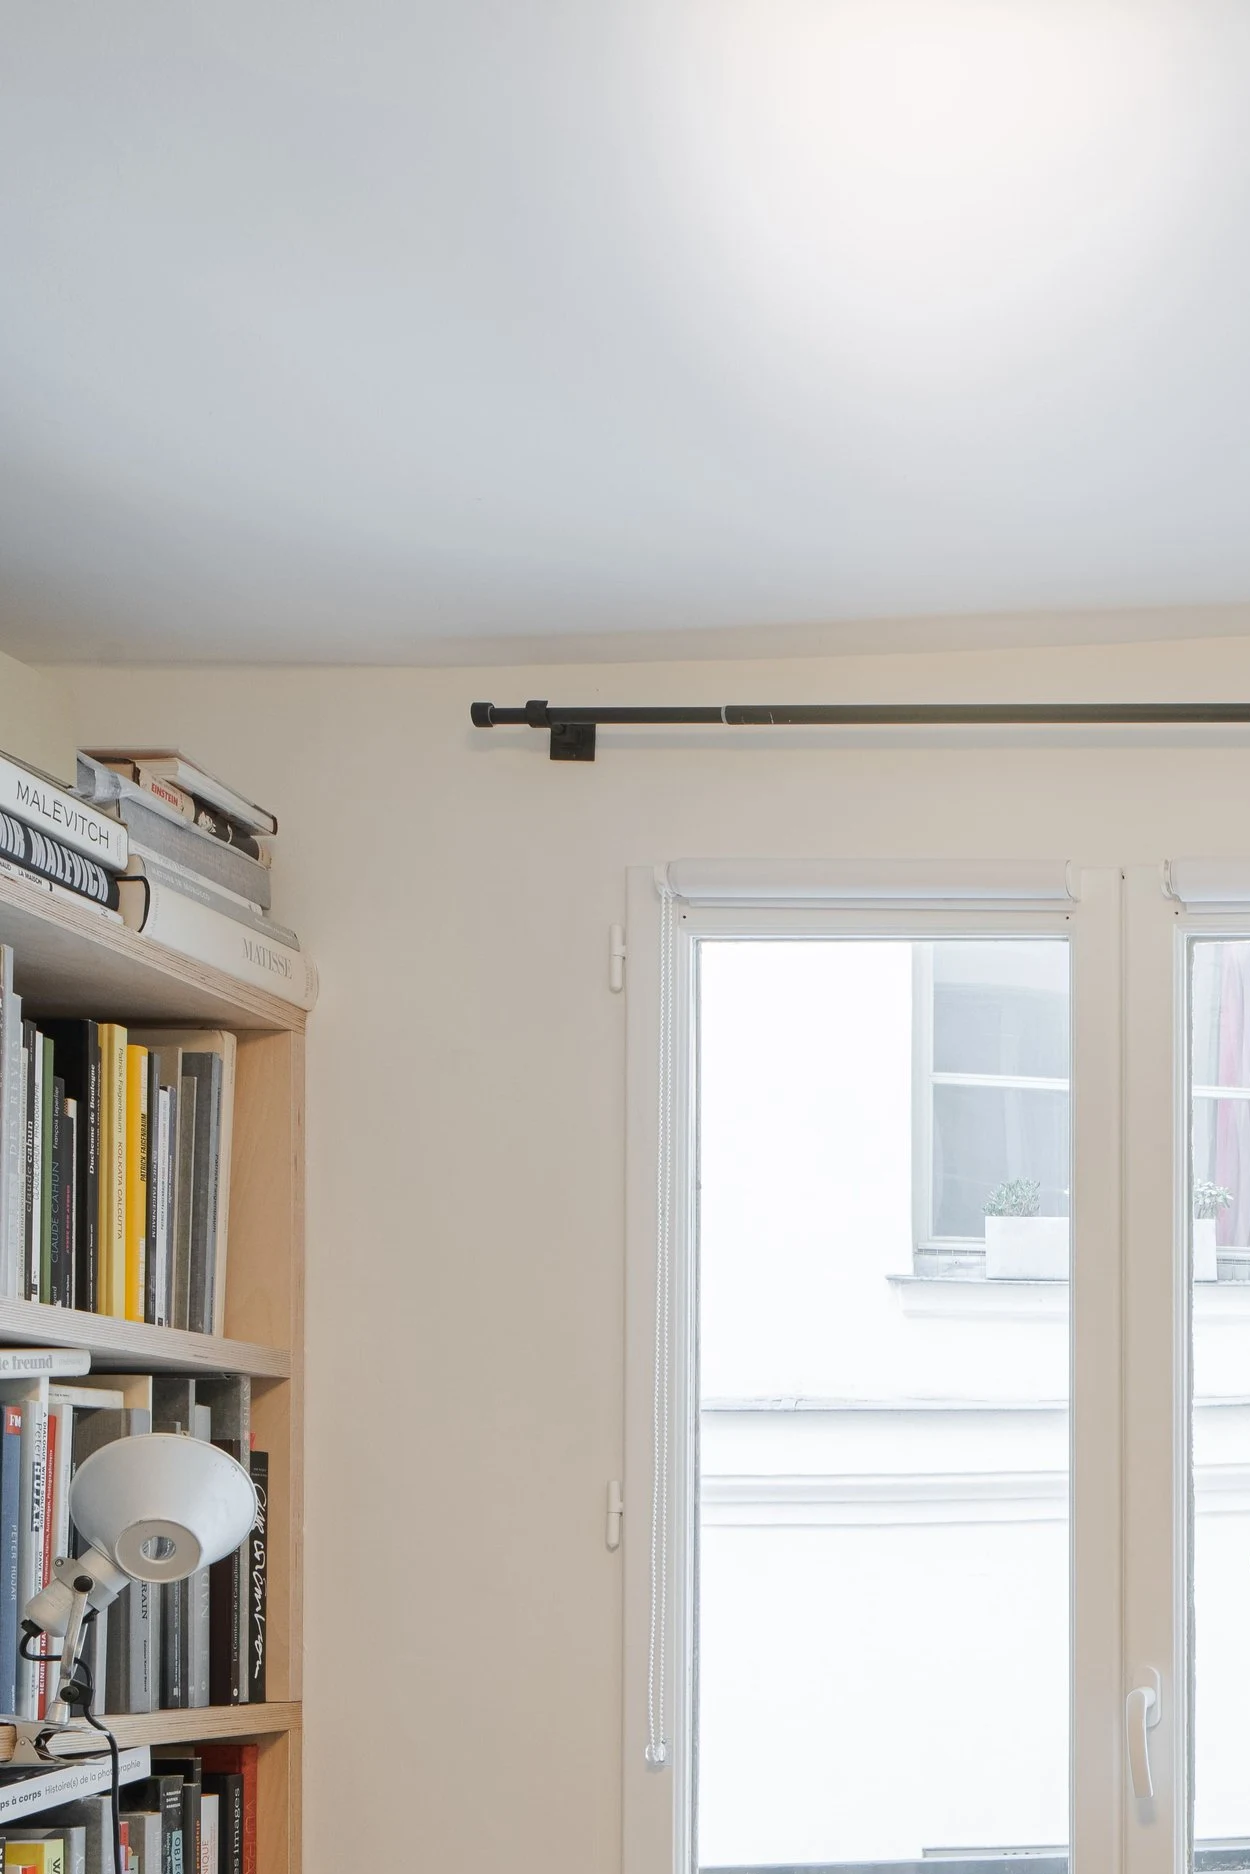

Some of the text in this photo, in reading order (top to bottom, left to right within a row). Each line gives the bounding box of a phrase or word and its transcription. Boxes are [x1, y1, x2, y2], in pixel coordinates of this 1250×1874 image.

[151, 782, 178, 807] EINSTEIN
[242, 938, 292, 980] MATISSE
[89, 1112, 95, 1124] de
[25, 1166, 33, 1212] claude
[51, 1161, 60, 1214] CAHUN
[51, 1218, 60, 1263] CLAUDE
[12, 1354, 53, 1370] freund
[11, 1795, 17, 1806] à
[18, 1789, 42, 1804] corps
[44, 1777, 79, 1796] Histoire(s)
[79, 1775, 89, 1785] de
[90, 1772, 96, 1782] la
